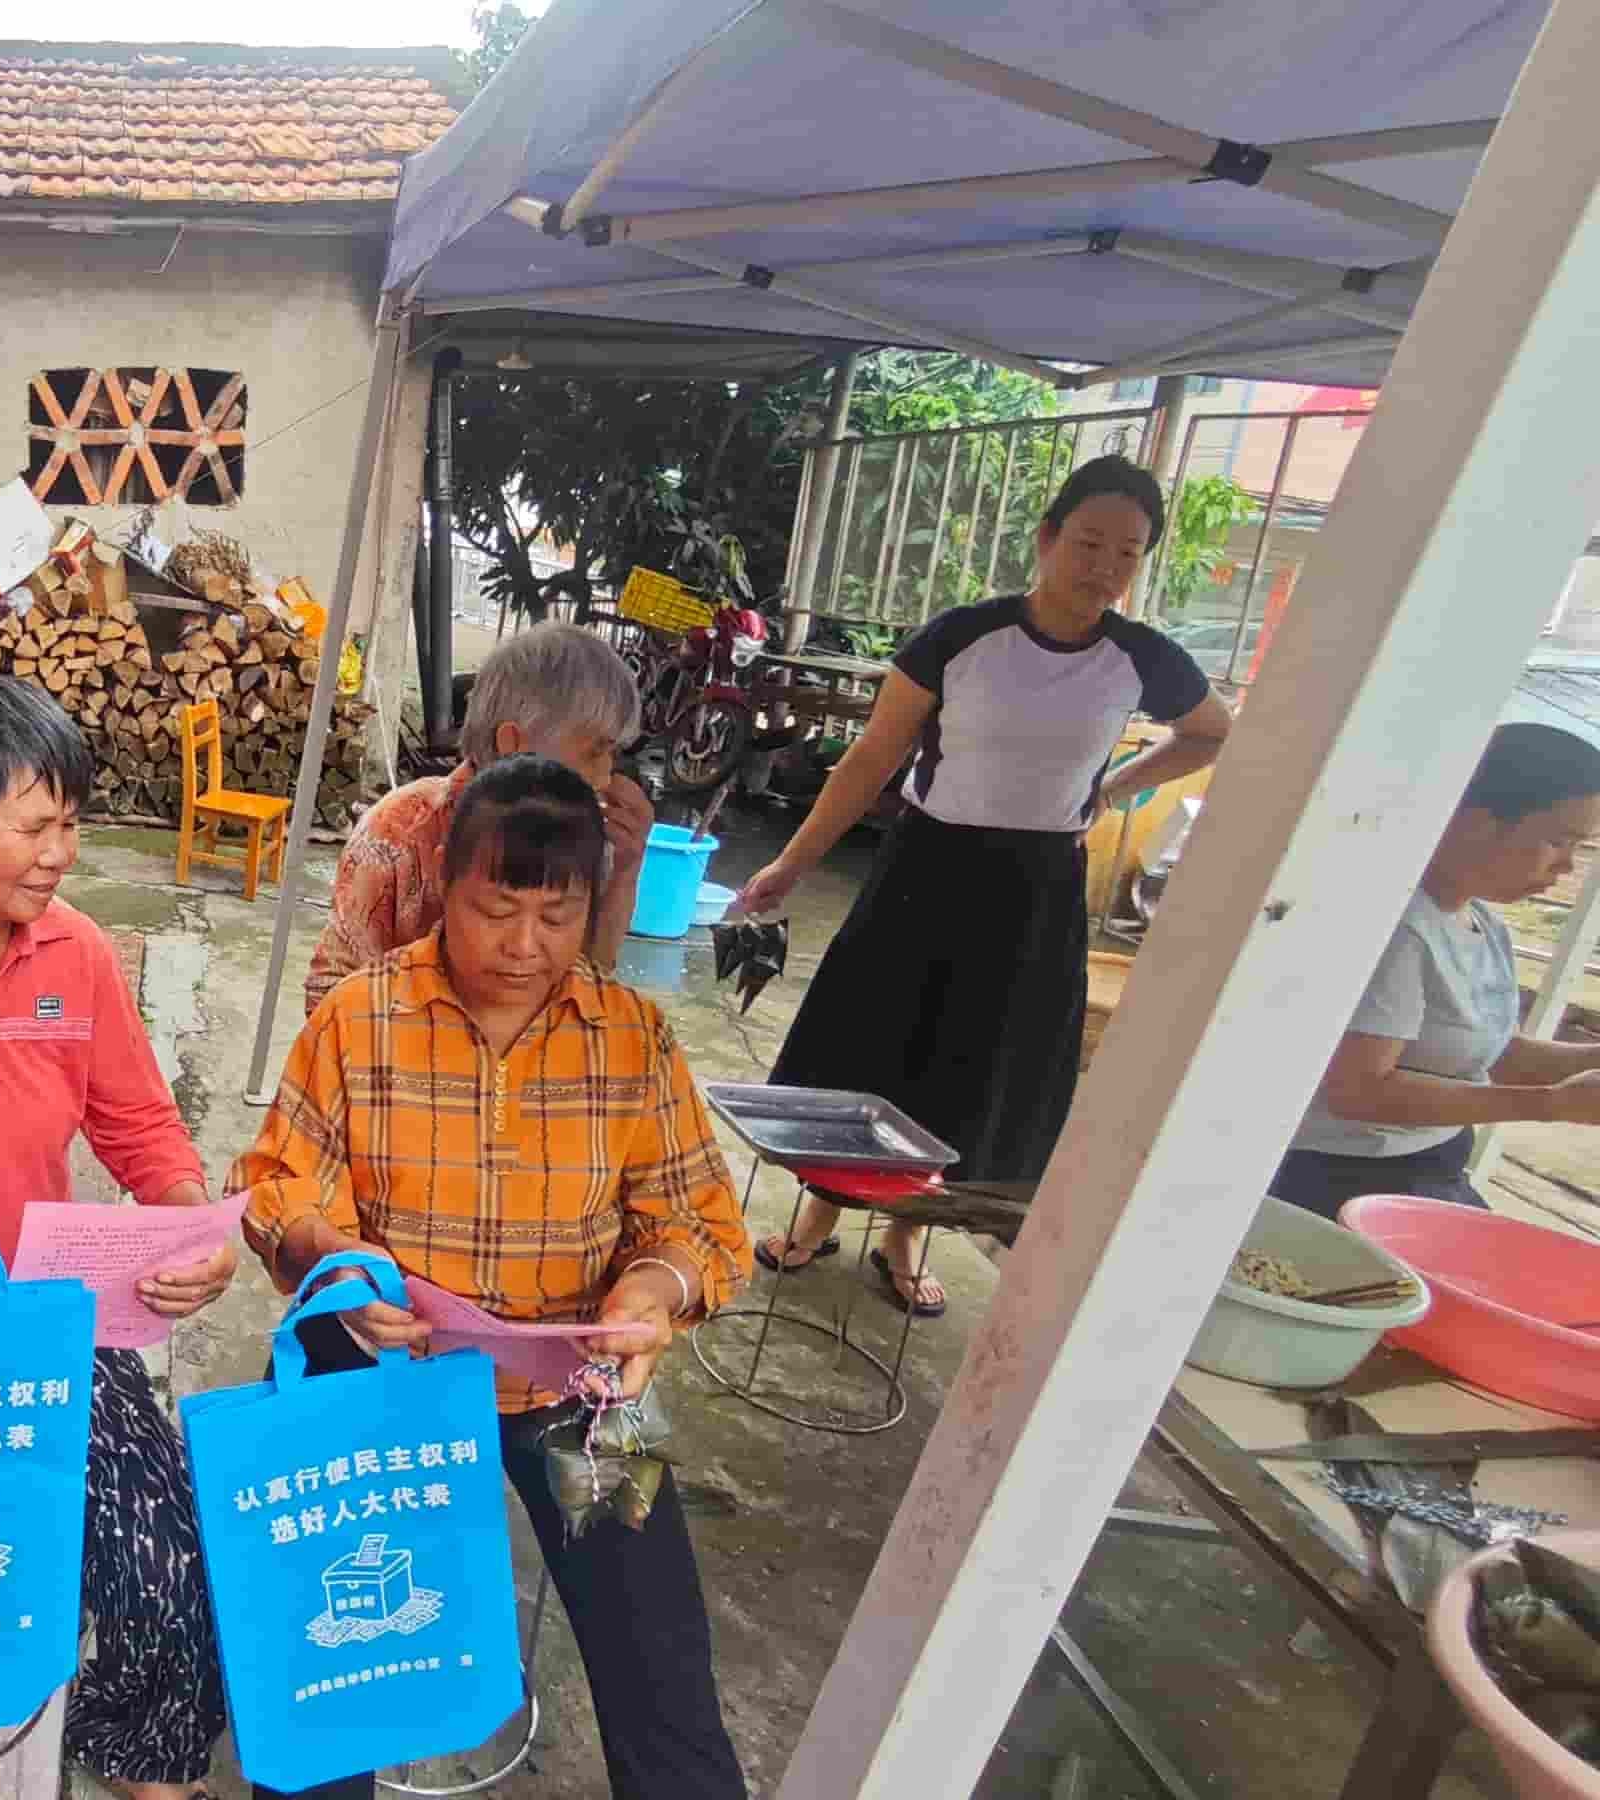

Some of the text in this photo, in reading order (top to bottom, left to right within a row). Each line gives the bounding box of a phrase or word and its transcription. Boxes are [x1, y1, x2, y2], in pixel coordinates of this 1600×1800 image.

[232, 1437, 479, 1512] 认真行使民主权利
[269, 1482, 452, 1545] 选好人大代表
